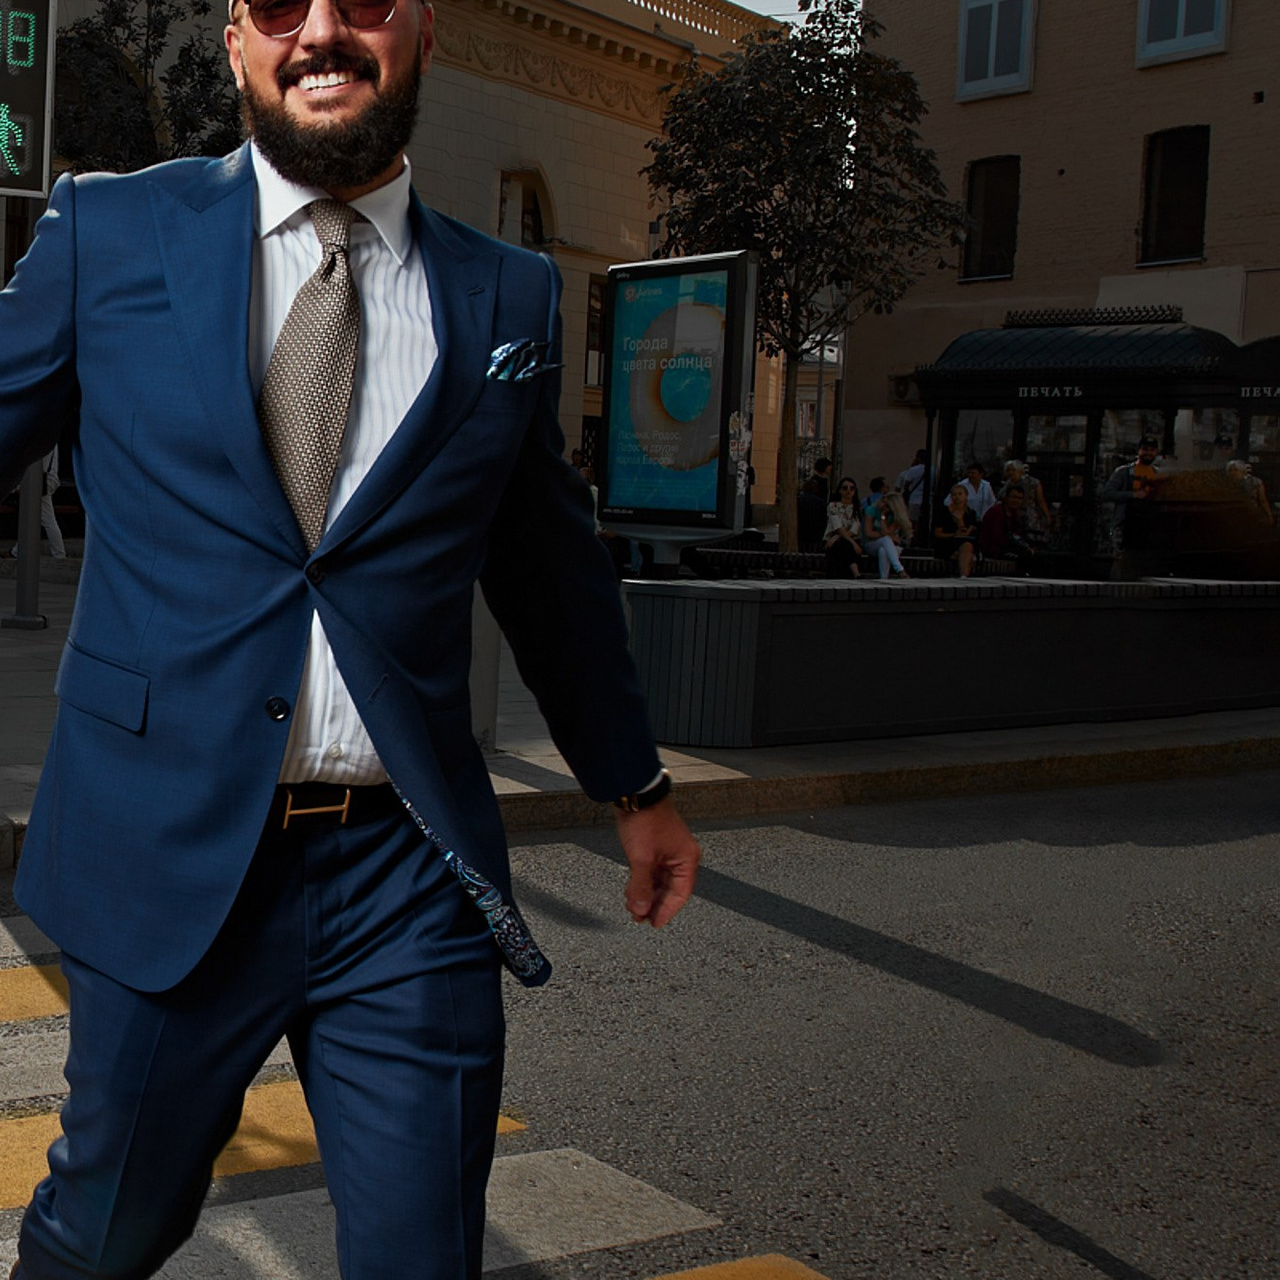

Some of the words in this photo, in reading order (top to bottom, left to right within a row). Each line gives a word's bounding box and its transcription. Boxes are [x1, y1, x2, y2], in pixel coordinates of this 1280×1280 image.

[623, 336, 668, 354] Города
[622, 360, 656, 374] цвета
[660, 355, 713, 372] солнца
[1018, 386, 1084, 398] ПЕЧАТЬ
